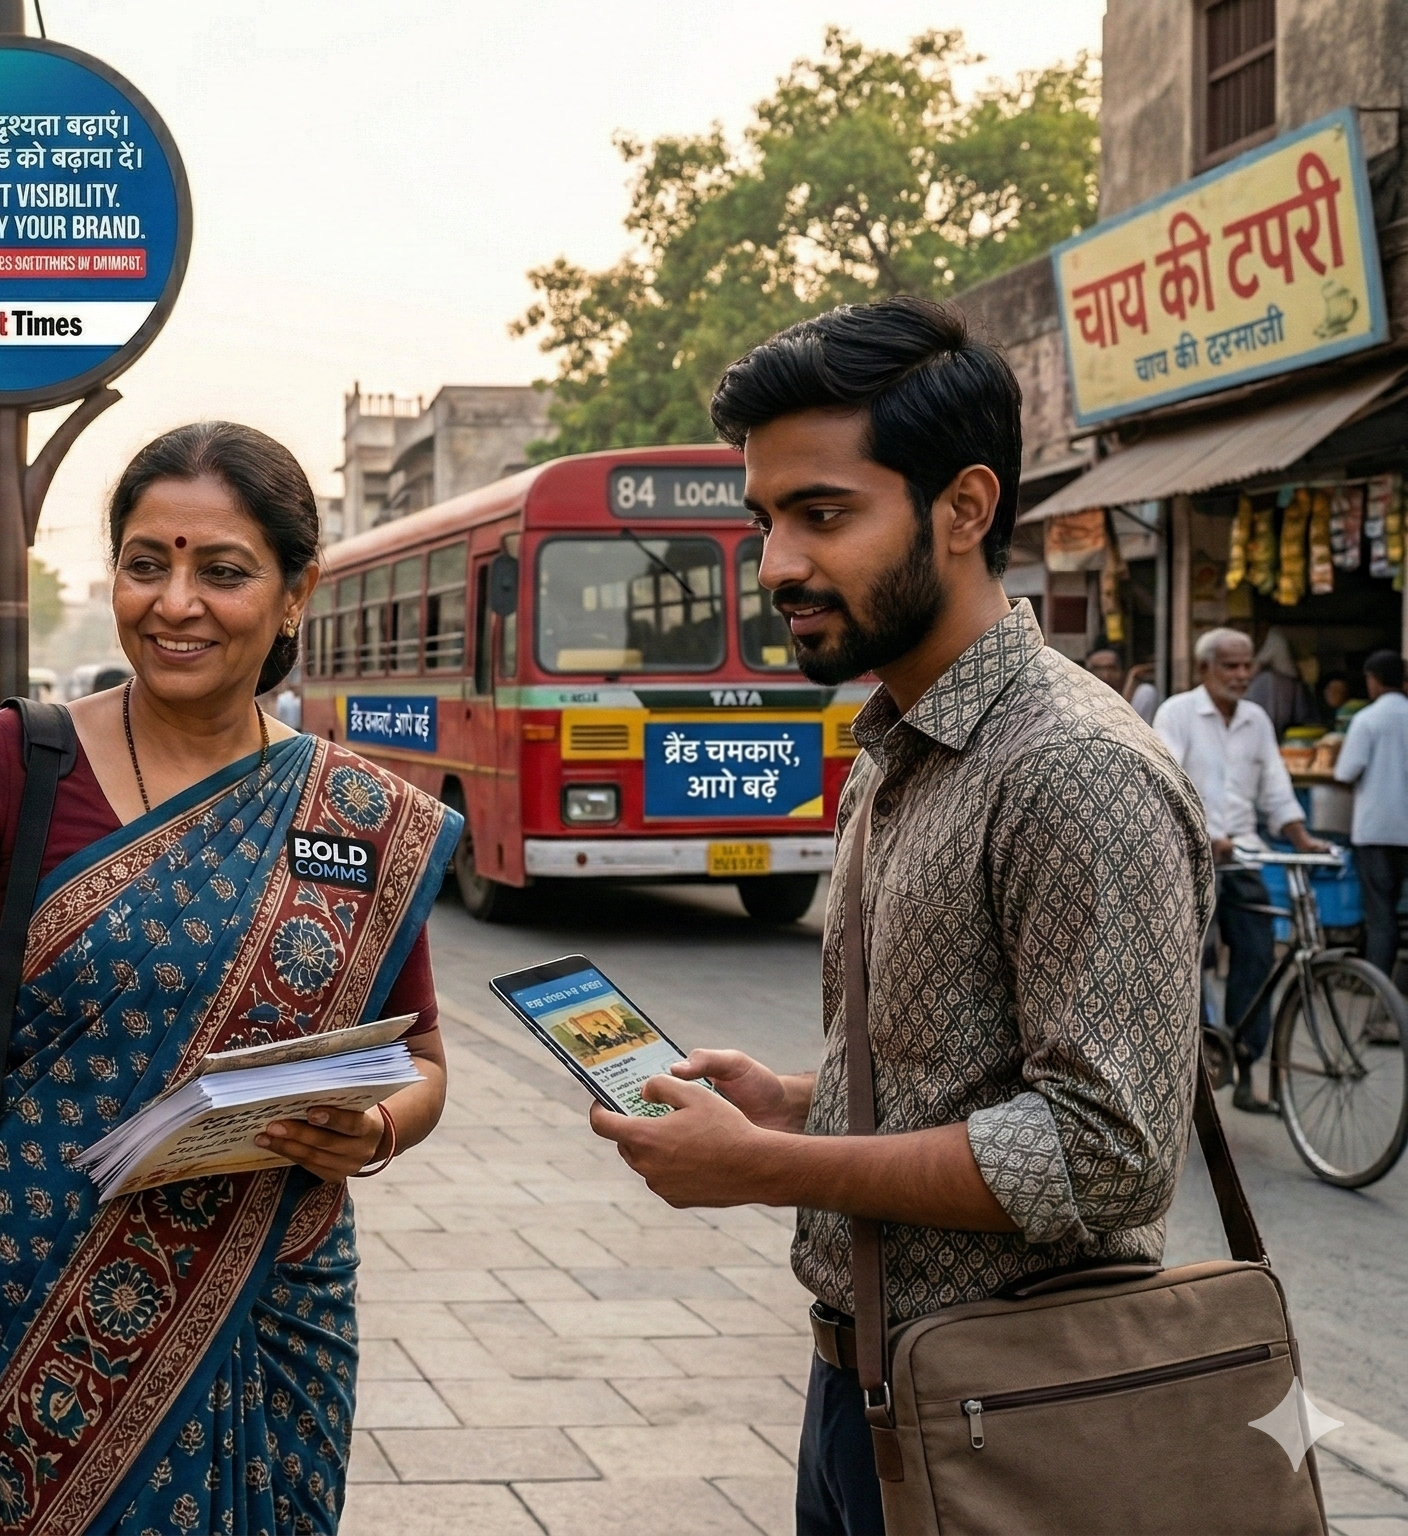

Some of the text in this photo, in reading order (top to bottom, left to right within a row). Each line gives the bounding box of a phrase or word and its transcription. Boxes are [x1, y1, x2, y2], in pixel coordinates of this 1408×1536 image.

[16, 141, 46, 169] को
[51, 148, 113, 174] बढ़ावा
[16, 183, 120, 208] VISIBILITY.
[14, 215, 67, 239] YOUR
[72, 215, 146, 240] BRAND.
[1071, 151, 1345, 349] चाय की टपरी
[11, 310, 83, 337] Times
[1174, 330, 1199, 370] की
[617, 475, 741, 509] 84 LOCAL
[710, 690, 763, 706] TATA
[663, 731, 800, 767] ब्रैंड चमकाएं,
[687, 768, 780, 804] आगे बढ़ें
[294, 837, 368, 867] BOLD
[295, 859, 368, 884] COMMS
